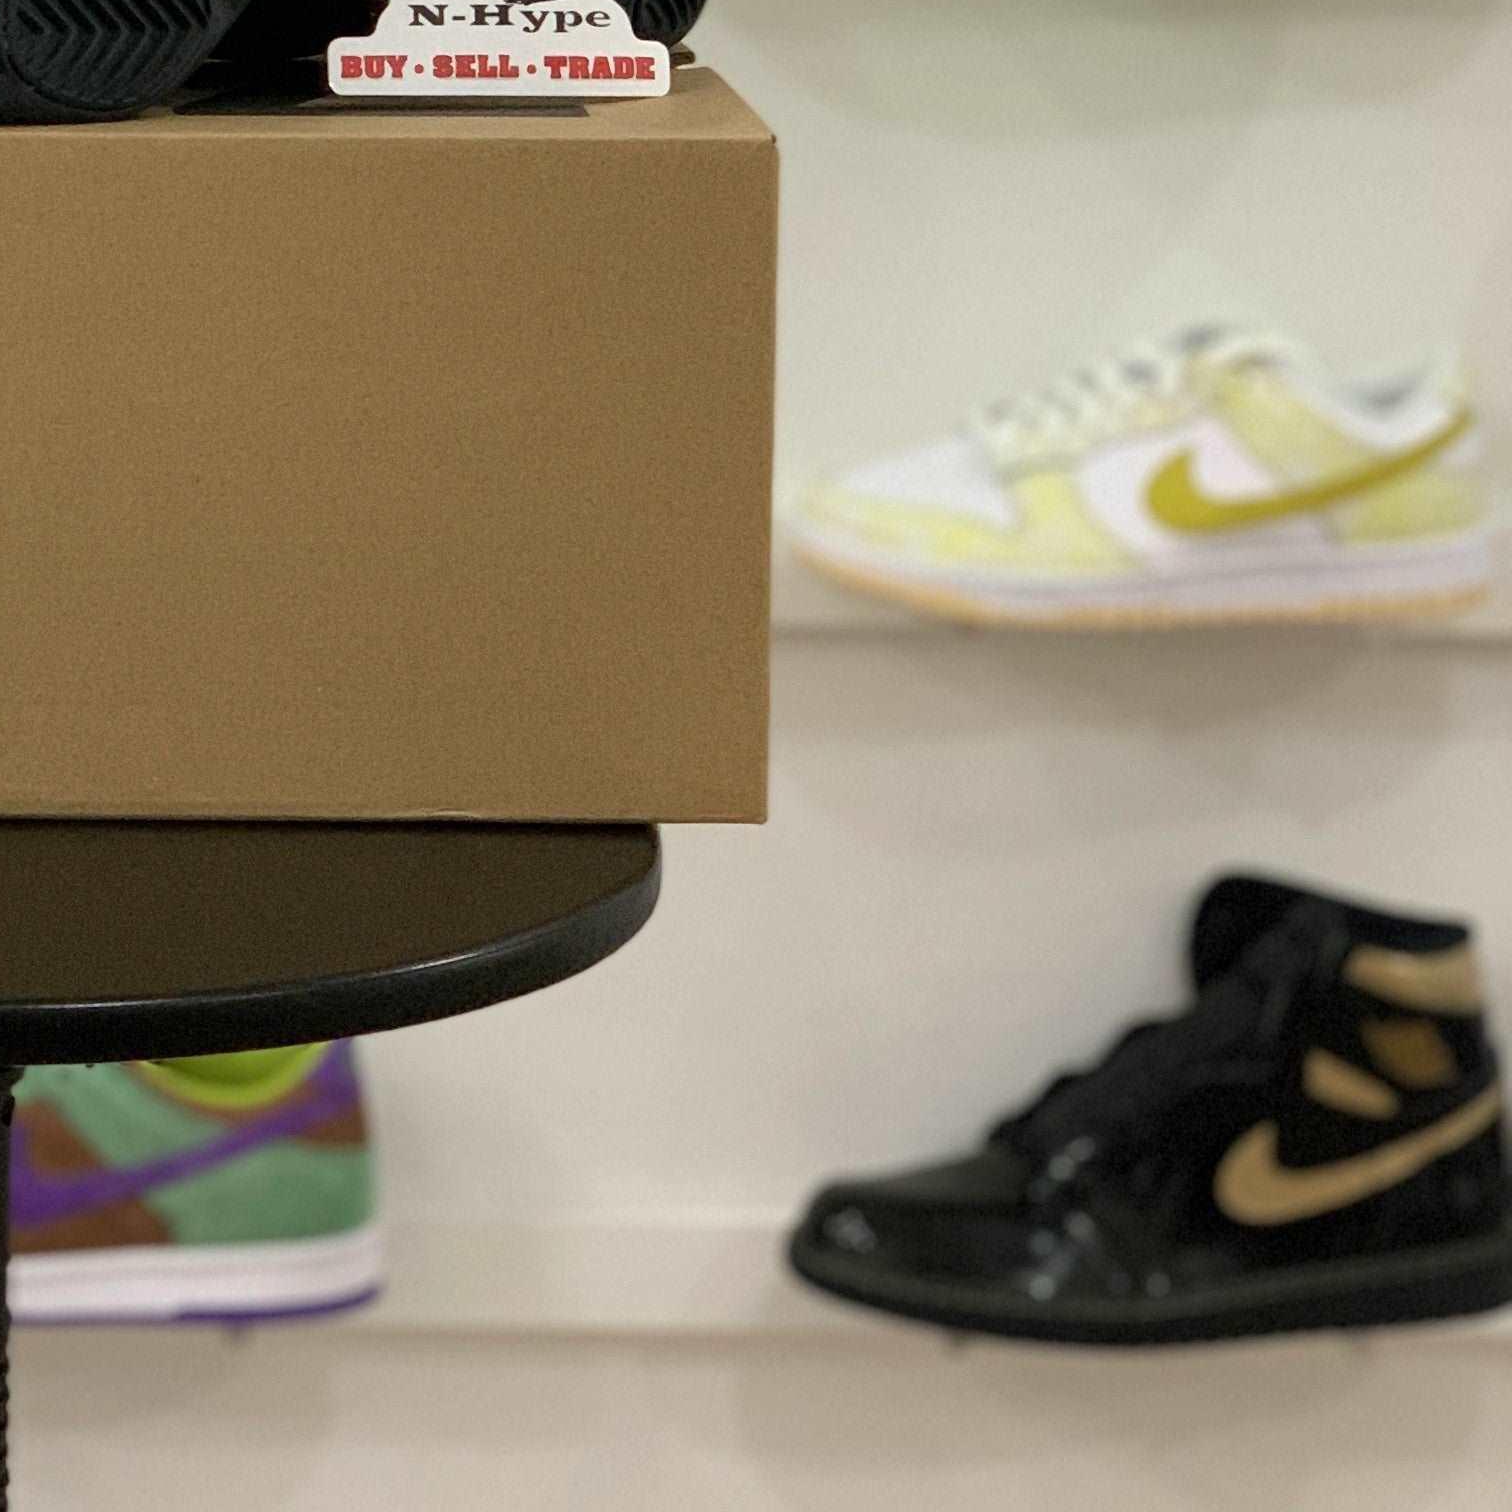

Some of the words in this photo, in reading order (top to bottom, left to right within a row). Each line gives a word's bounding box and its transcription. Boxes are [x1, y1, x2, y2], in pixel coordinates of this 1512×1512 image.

[408, 4, 611, 33] N-Hype
[340, 55, 408, 79] BUY
[432, 54, 520, 79] SELL
[544, 55, 656, 80] TRADE
